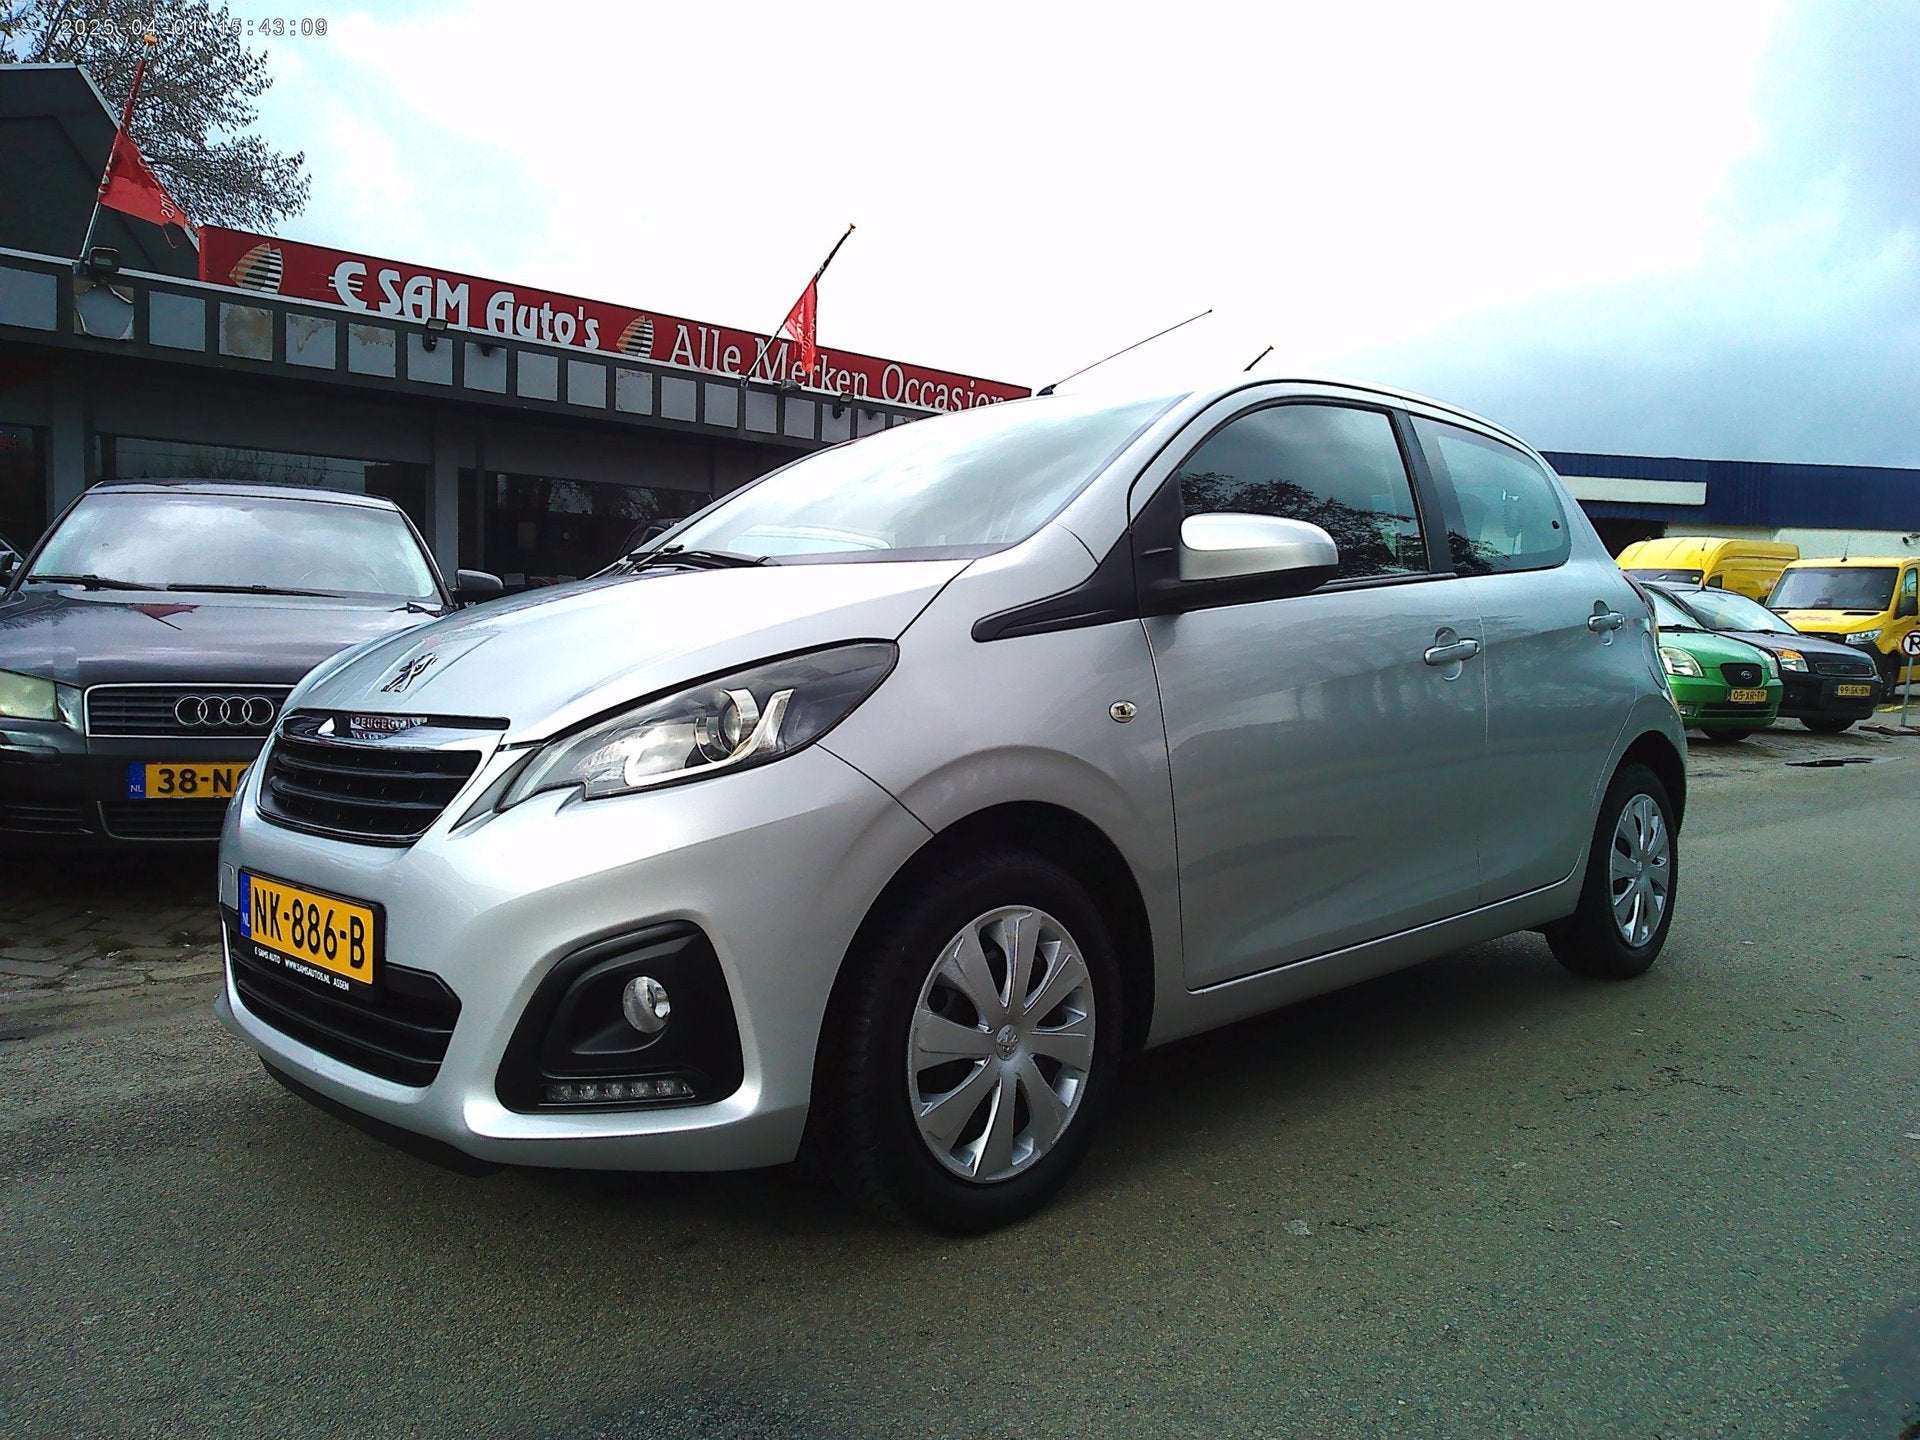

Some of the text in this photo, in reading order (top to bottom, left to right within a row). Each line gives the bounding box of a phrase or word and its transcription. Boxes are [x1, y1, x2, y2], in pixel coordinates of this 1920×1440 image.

[379, 268, 469, 329] SAM
[486, 291, 599, 350] Auto's
[669, 324, 742, 376] Alle
[752, 336, 869, 398] Merken
[130, 784, 144, 793] NL
[157, 768, 249, 793] 38-N
[242, 912, 250, 927] NL
[254, 887, 365, 970] NK-886-B
[332, 977, 349, 991] ASSEN
